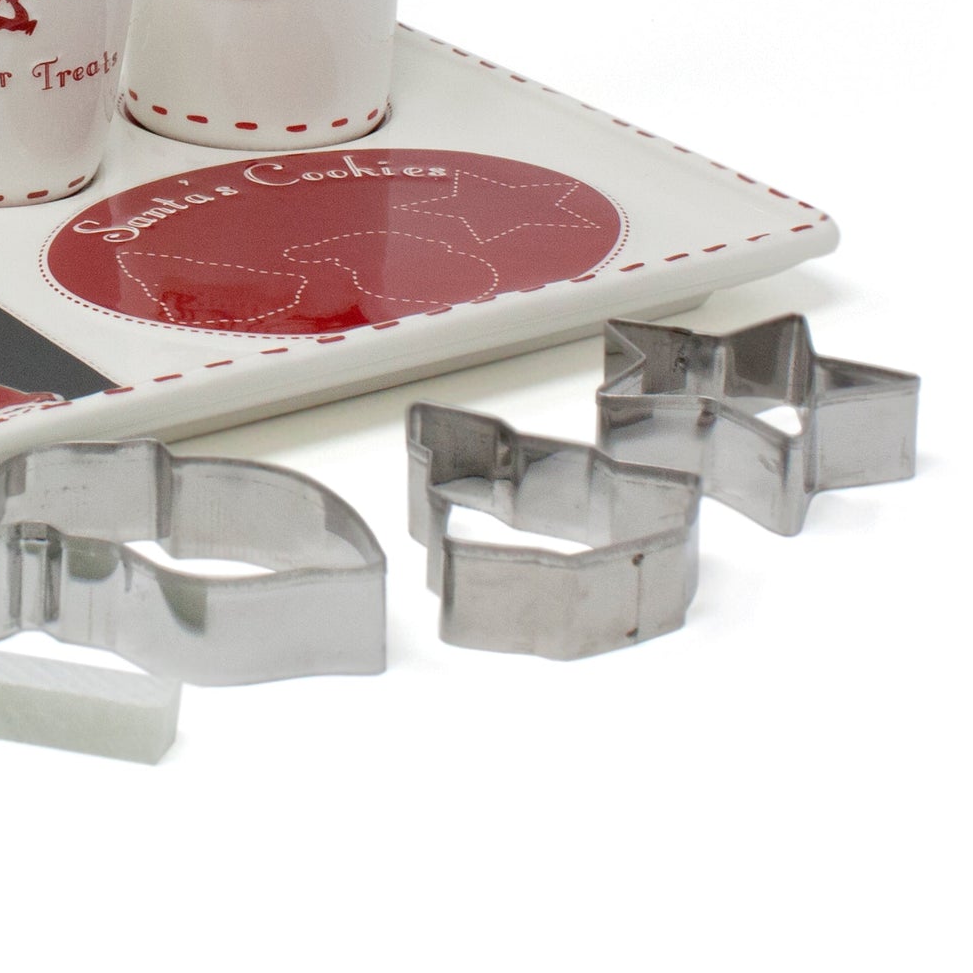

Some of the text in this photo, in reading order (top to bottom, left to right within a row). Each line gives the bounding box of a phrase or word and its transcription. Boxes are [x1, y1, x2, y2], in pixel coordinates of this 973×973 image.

[31, 50, 119, 91] Treats
[73, 155, 449, 245] Santa's Cookies
